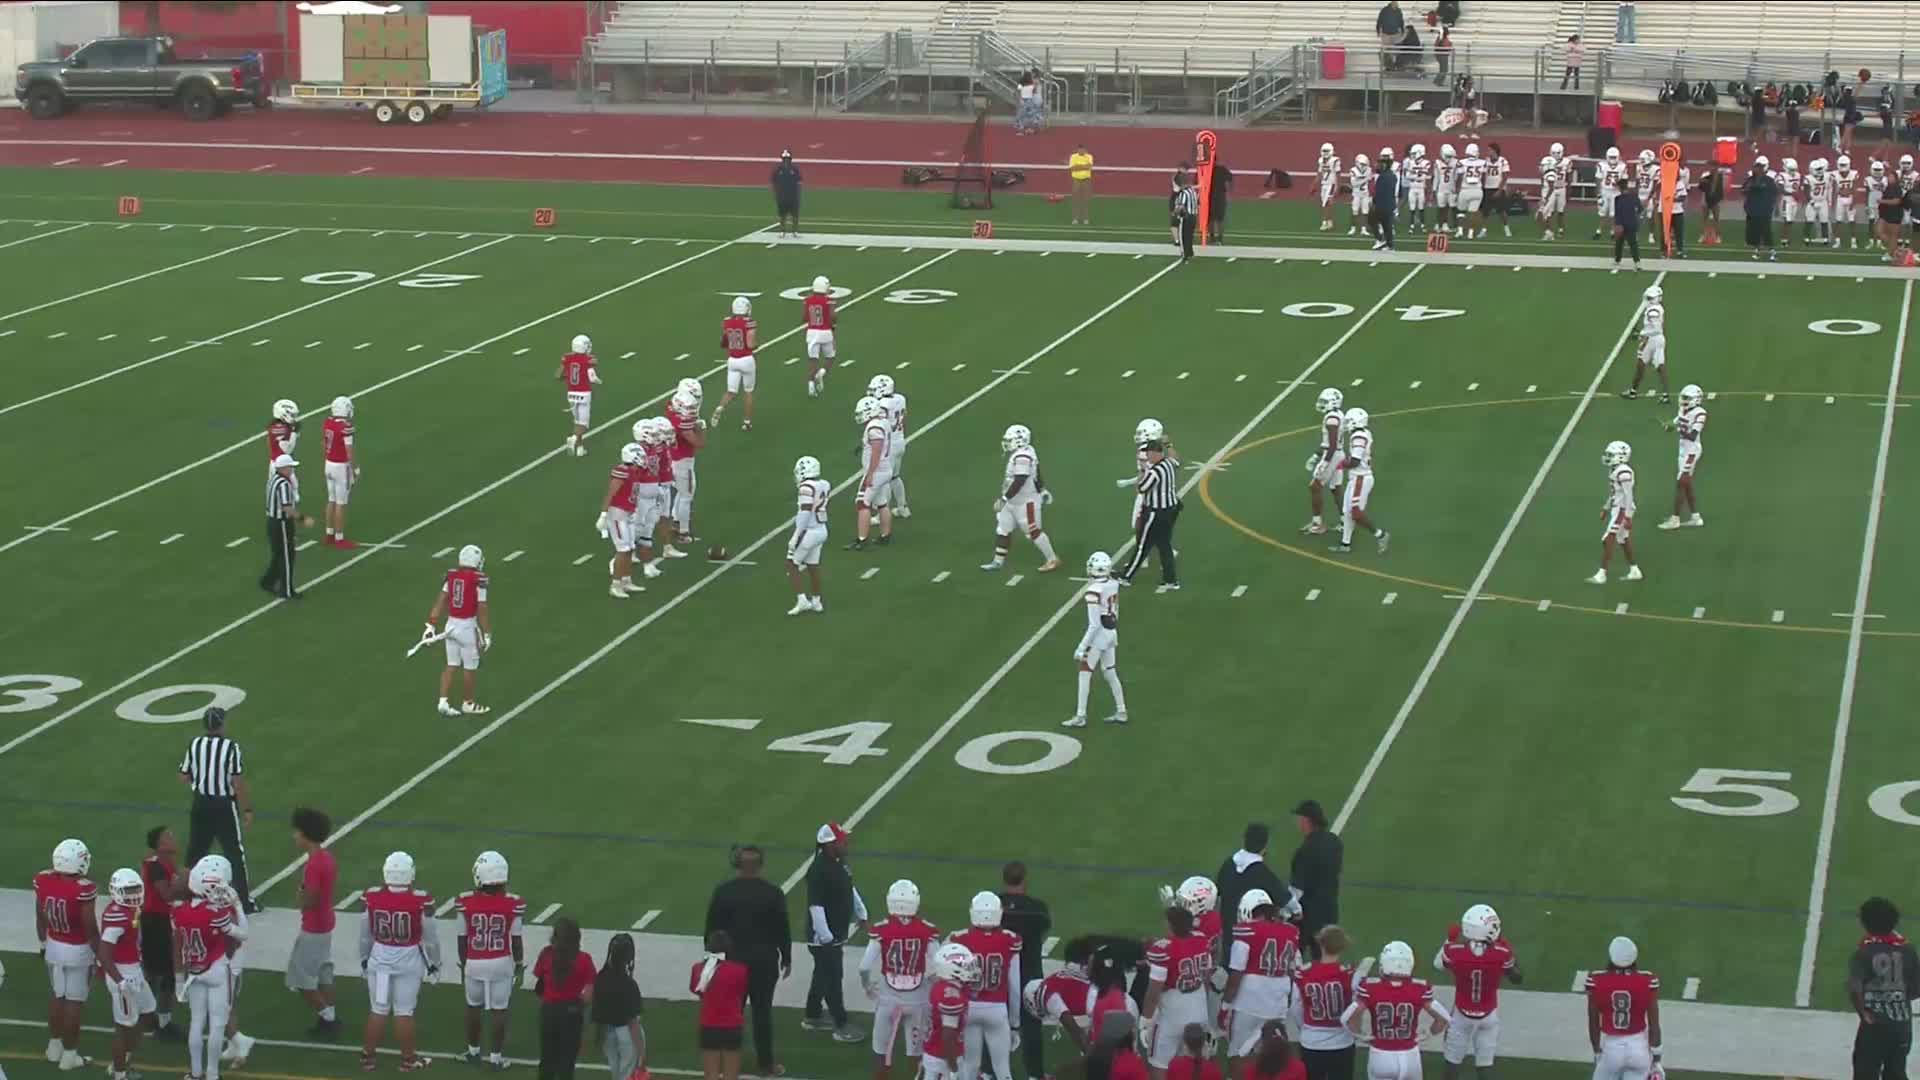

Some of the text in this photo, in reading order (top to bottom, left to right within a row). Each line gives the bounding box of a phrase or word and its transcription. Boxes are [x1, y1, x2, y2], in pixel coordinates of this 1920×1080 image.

[1466, 166, 1481, 177] 55
[122, 198, 135, 212] 10
[535, 209, 552, 225] 20
[973, 222, 989, 237] 30
[1429, 234, 1446, 252] 40
[767, 721, 1082, 774] 40
[373, 909, 412, 943] 60
[471, 913, 506, 951] 32
[886, 938, 921, 977] 47
[1258, 938, 1298, 978] 44
[1872, 952, 1903, 988] 91
[1304, 980, 1345, 1021] 30
[1471, 969, 1483, 1003] 1
[1375, 1002, 1415, 1041] 23
[1611, 990, 1632, 1030] 8
